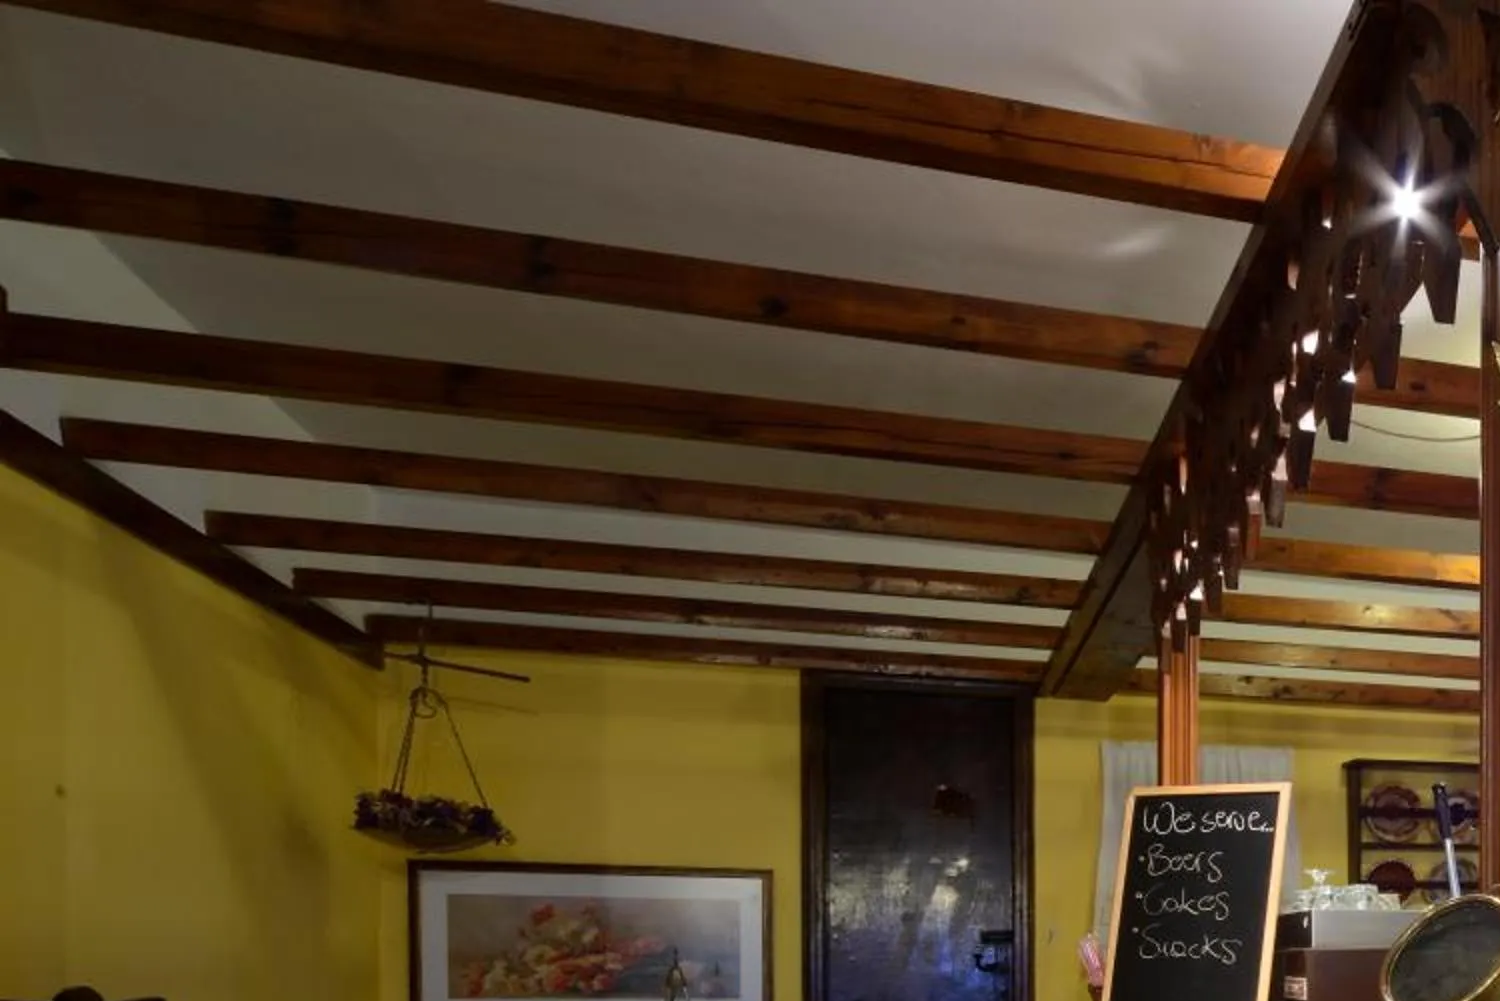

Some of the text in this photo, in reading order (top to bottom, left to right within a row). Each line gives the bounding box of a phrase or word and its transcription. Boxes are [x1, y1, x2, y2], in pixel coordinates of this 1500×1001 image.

[1143, 801, 1196, 835] We
[1143, 883, 1230, 921] Cakes
[1139, 923, 1243, 965] Snacks
